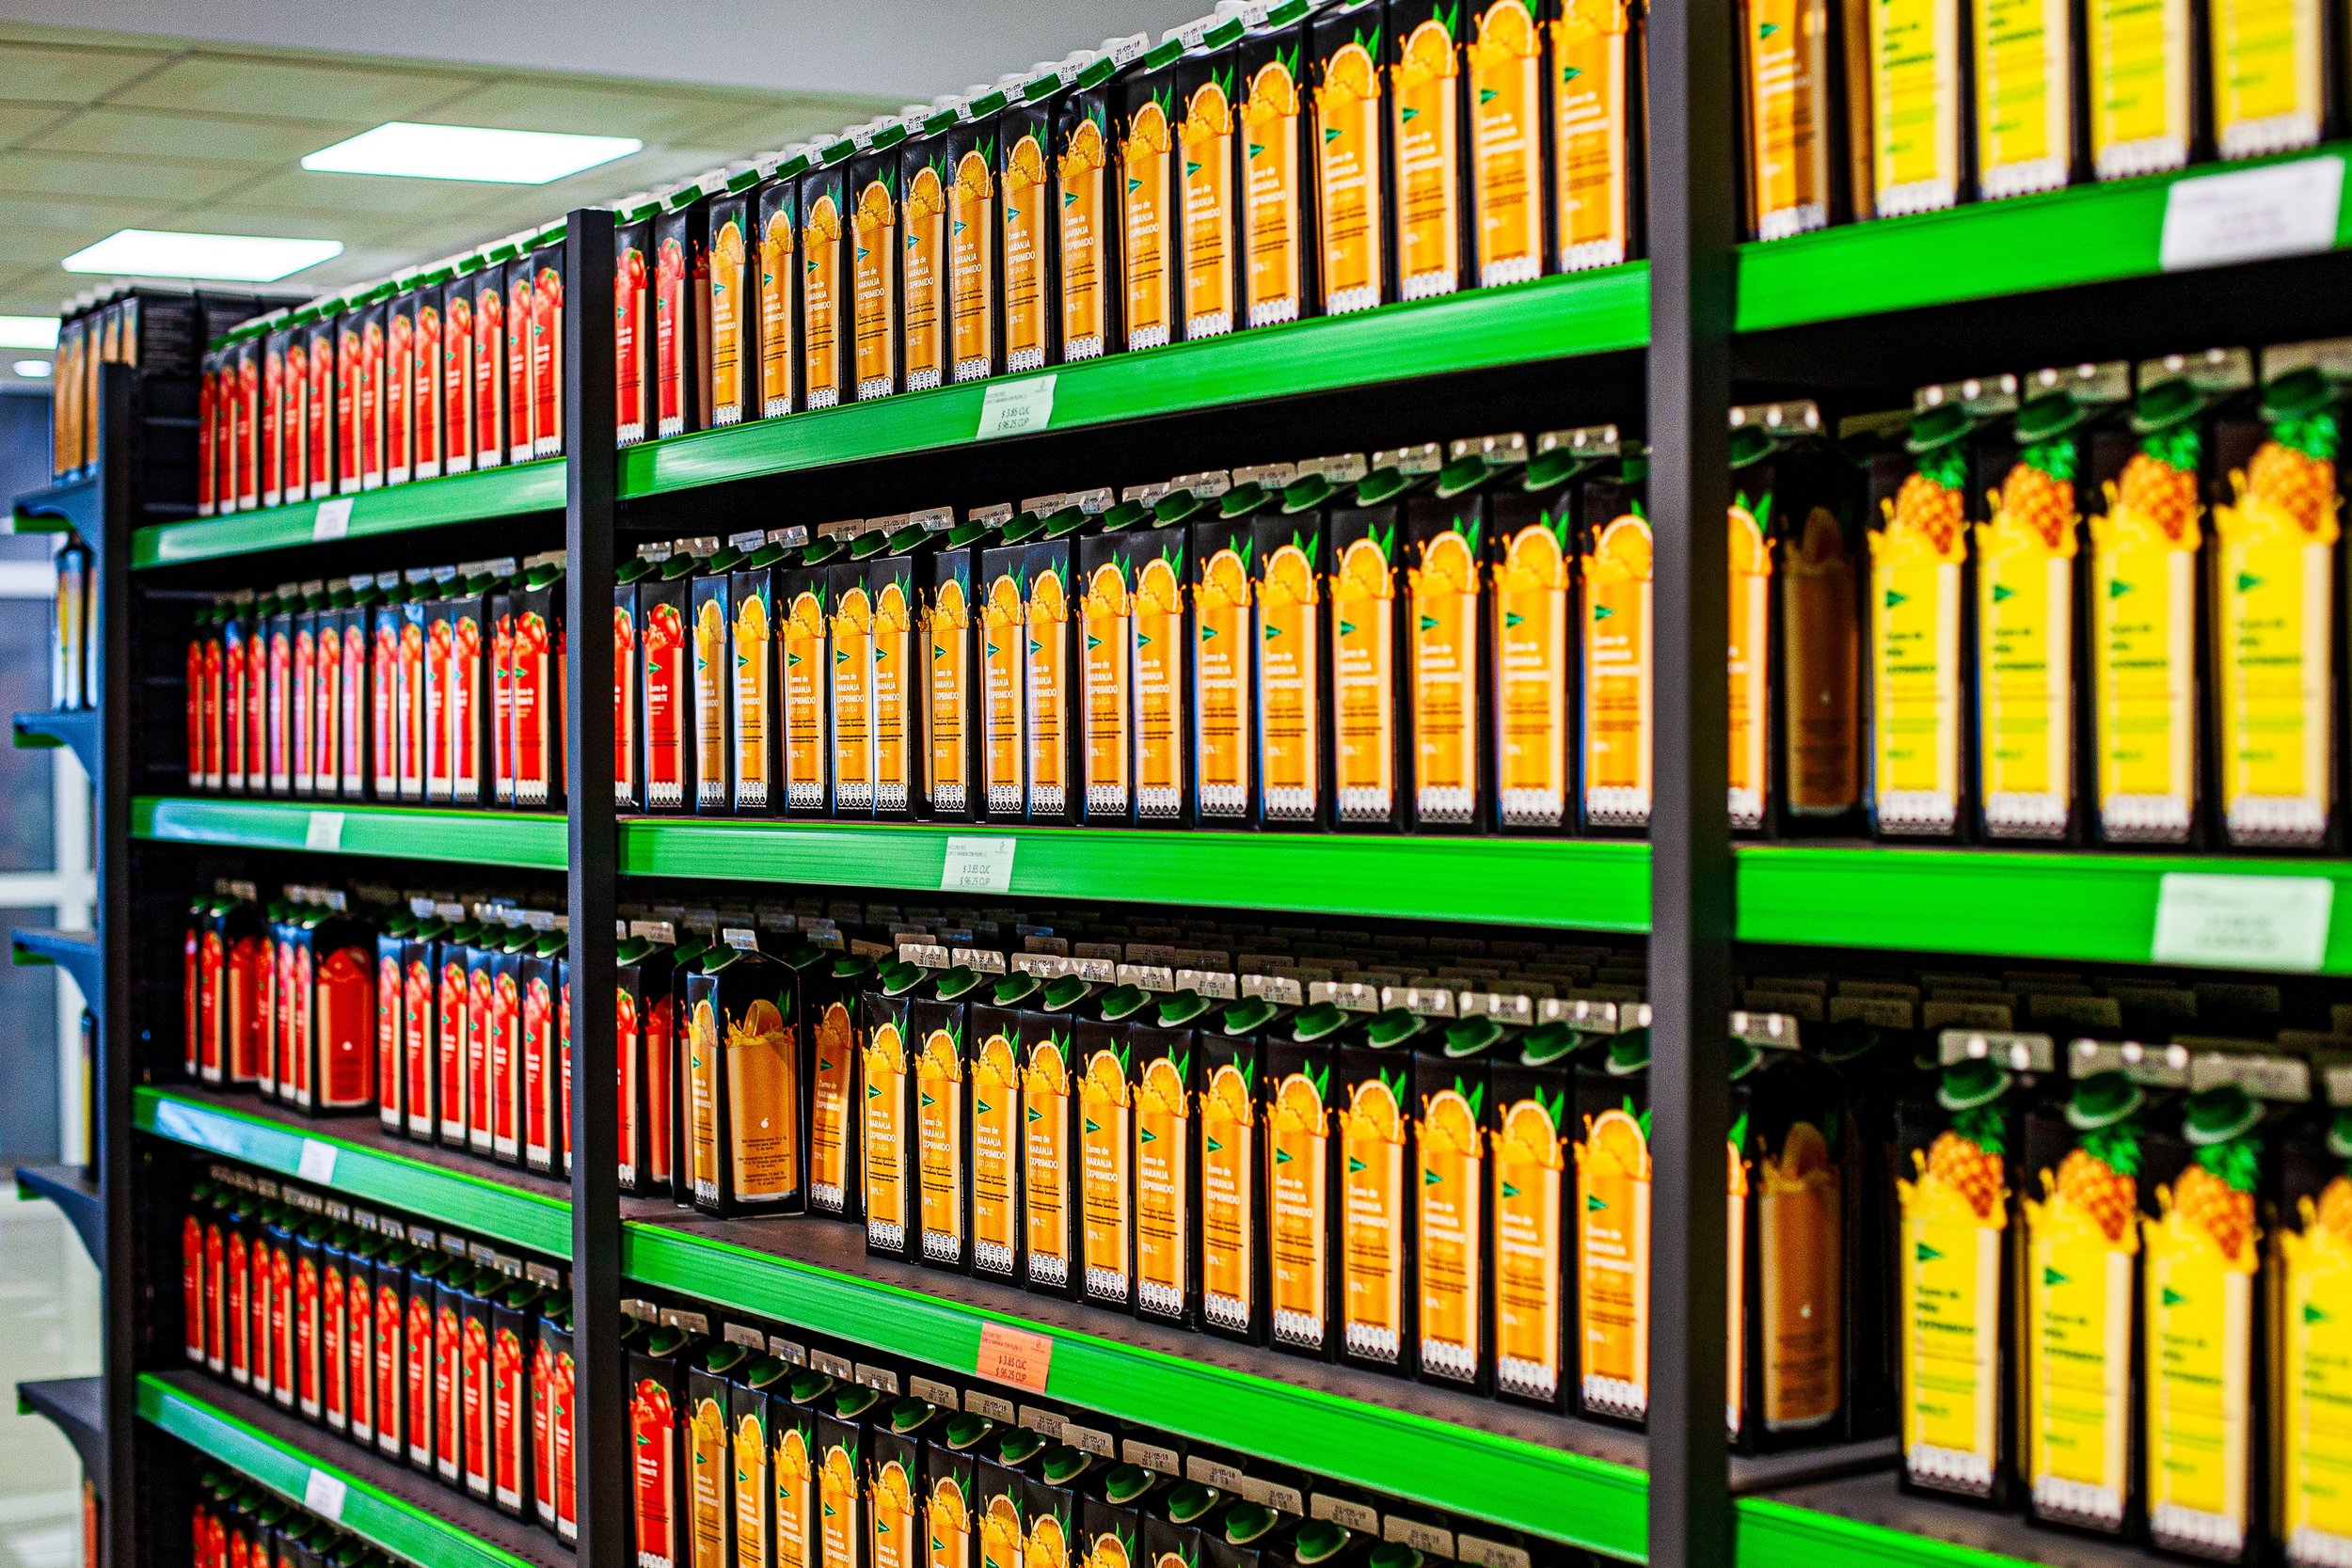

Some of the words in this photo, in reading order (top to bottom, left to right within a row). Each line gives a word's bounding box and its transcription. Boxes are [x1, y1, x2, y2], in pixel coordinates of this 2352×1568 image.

[1129, 203, 1143, 214] Zumo
[1144, 200, 1151, 209] de
[1065, 216, 1077, 226] Zumo
[1079, 214, 1086, 222] de
[1129, 212, 1153, 226] NARANJA
[1009, 230, 1019, 241] Zumo
[1020, 229, 1027, 237] de
[1065, 225, 1089, 239] NARANJA
[1129, 223, 1159, 238] EXPRIMIDO
[954, 243, 965, 253] Zumo
[966, 242, 974, 250] de
[1009, 240, 1030, 252] NARANJA
[1065, 237, 1093, 251] EXPRIMIDO
[955, 253, 977, 265] NARANJA
[1009, 251, 1035, 265] EXPRIMIDO
[858, 269, 870, 278] Zumo
[908, 267, 929, 278] NARANJA
[955, 263, 981, 277] EXPRIMIDO
[858, 277, 880, 290] NARANJA
[908, 277, 933, 290] EXPRIMIDO
[808, 292, 826, 301] NARANJA
[858, 288, 884, 301] EXPRIMIDO
[808, 301, 831, 312] EXPRIMIDO
[997, 421, 1001, 431] $
[1031, 665, 1041, 673] Zumo
[1042, 664, 1049, 673] de
[1088, 661, 1102, 670] Zumo
[1103, 660, 1109, 669] de
[988, 667, 998, 675] Zumo
[789, 675, 801, 684] Zumo
[837, 673, 849, 681] Zumo
[988, 678, 1009, 687] NARANJA
[1031, 676, 1052, 686] NARANJA
[1088, 673, 1113, 682] NARANJA
[876, 682, 896, 690] NARANJA
[1088, 685, 1118, 694] EXPRIMIDO
[876, 693, 899, 702] EXPRIMIDO
[935, 691, 959, 700] EXPRIMIDO
[988, 689, 1014, 698] EXPRIMIDO
[1031, 689, 1057, 697] EXPRIMIDO
[789, 696, 816, 705] EXPRIMIDO
[837, 694, 864, 704] EXPRIMIDO
[961, 877, 963, 885] $
[869, 1108, 882, 1117] Zumo
[869, 1119, 891, 1130] NARANJA
[923, 1117, 934, 1126] Zumo
[935, 1118, 942, 1127] de
[923, 1128, 946, 1139] NARANJA
[977, 1123, 991, 1133] Zumo
[992, 1125, 998, 1134] de
[869, 1132, 896, 1142] EXPRIMIDO
[977, 1135, 1001, 1147] NARANJA
[1029, 1132, 1042, 1142] Zumo
[1043, 1134, 1050, 1143] de
[923, 1141, 950, 1152] EXPRIMIDO
[1029, 1145, 1053, 1156] NARANJA
[1086, 1143, 1100, 1153] Zumo
[1102, 1146, 1108, 1156] de
[977, 1148, 1006, 1160] EXPRIMIDO
[1141, 1153, 1156, 1164] Zumo
[1157, 1156, 1166, 1166] de
[1029, 1158, 1058, 1169] EXPRIMIDO
[1086, 1156, 1112, 1169] NARANJA
[1087, 1169, 1118, 1182] EXPRIMIDO
[1141, 1166, 1168, 1180] NARANJA
[1141, 1180, 1174, 1195] EXPRIMIDO
[998, 1355, 1002, 1364] $
[1003, 1356, 1014, 1367] 3.85
[1016, 1359, 1026, 1370] CUC
[996, 1368, 999, 1377] $
[1000, 1369, 1014, 1380] 96.25
[1016, 1372, 1026, 1382] CUP
